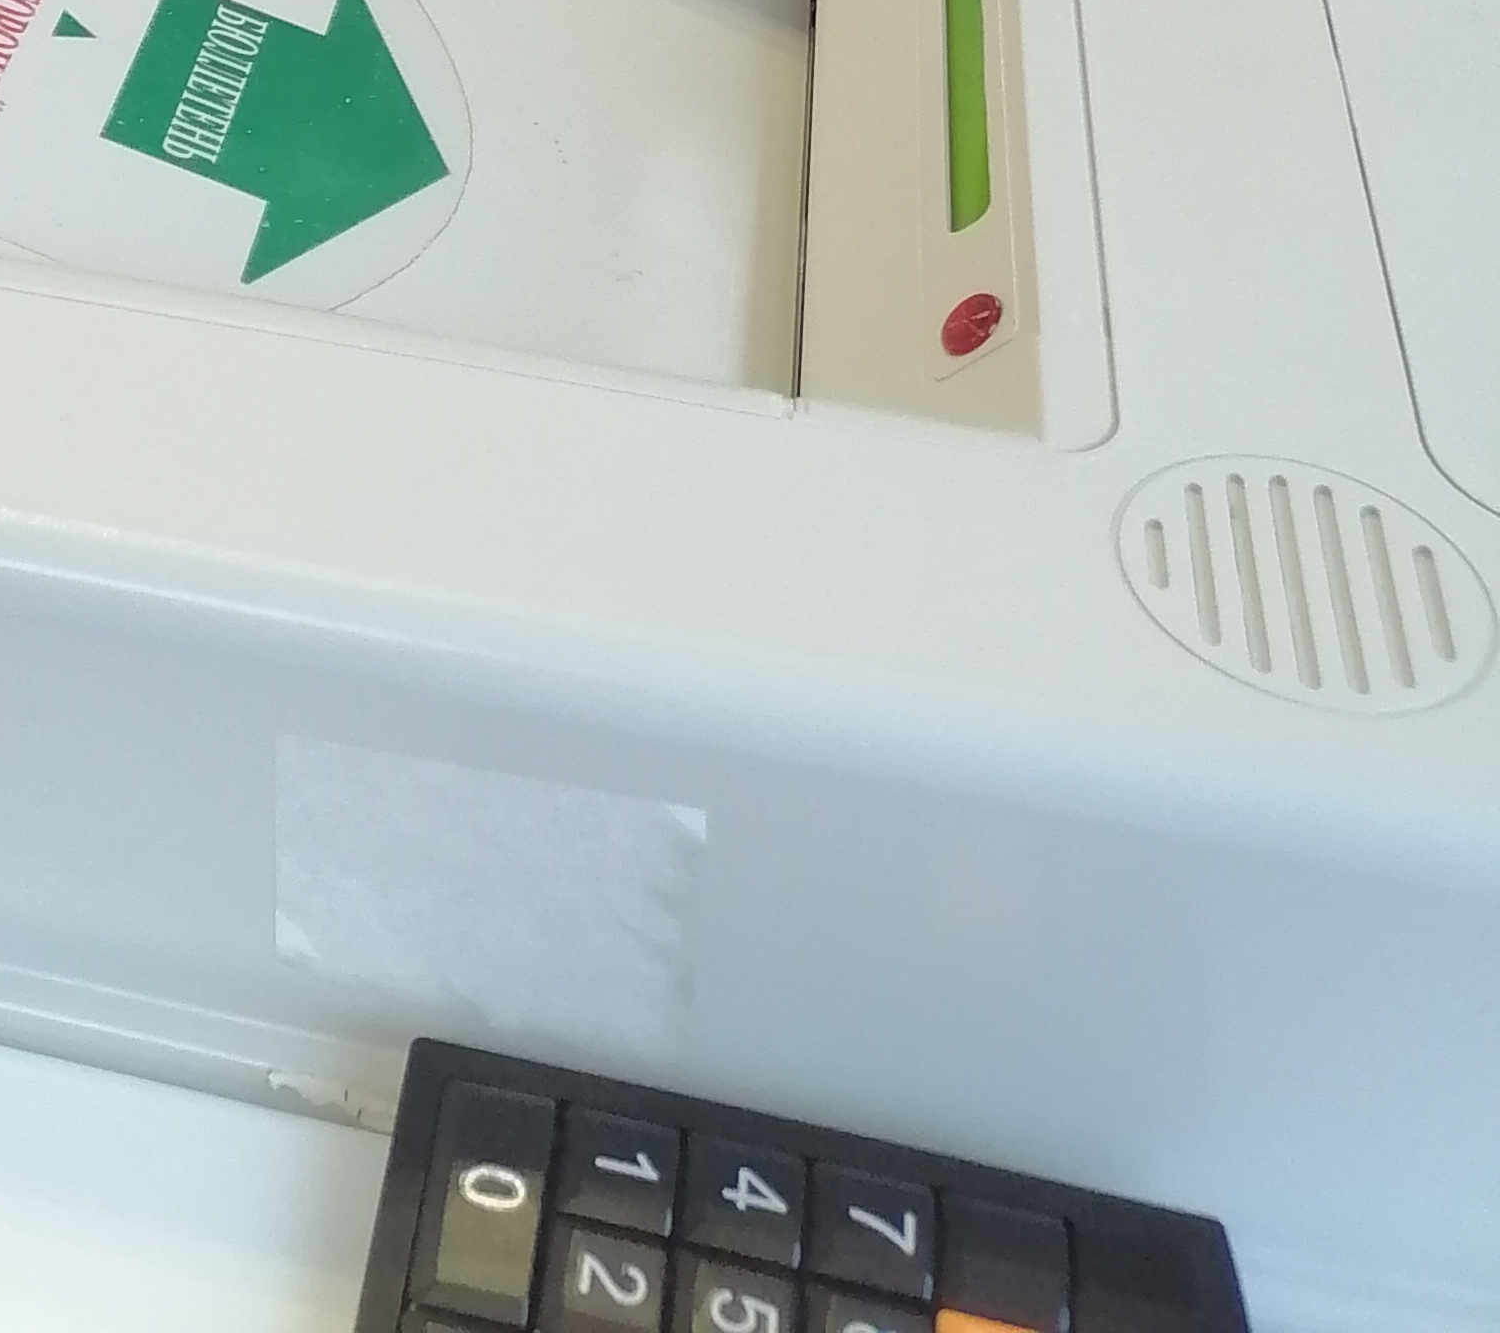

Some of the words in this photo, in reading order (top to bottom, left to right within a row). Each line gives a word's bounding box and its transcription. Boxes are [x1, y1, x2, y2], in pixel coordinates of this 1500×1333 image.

[163, 4, 268, 164] БЮЛЛЕТЕНЬ
[459, 1164, 527, 1211] 0
[594, 1152, 660, 1183] 1
[721, 1166, 789, 1215] 4
[847, 1204, 918, 1256] 7
[577, 1250, 649, 1307] 2
[709, 1286, 781, 1333] 5
